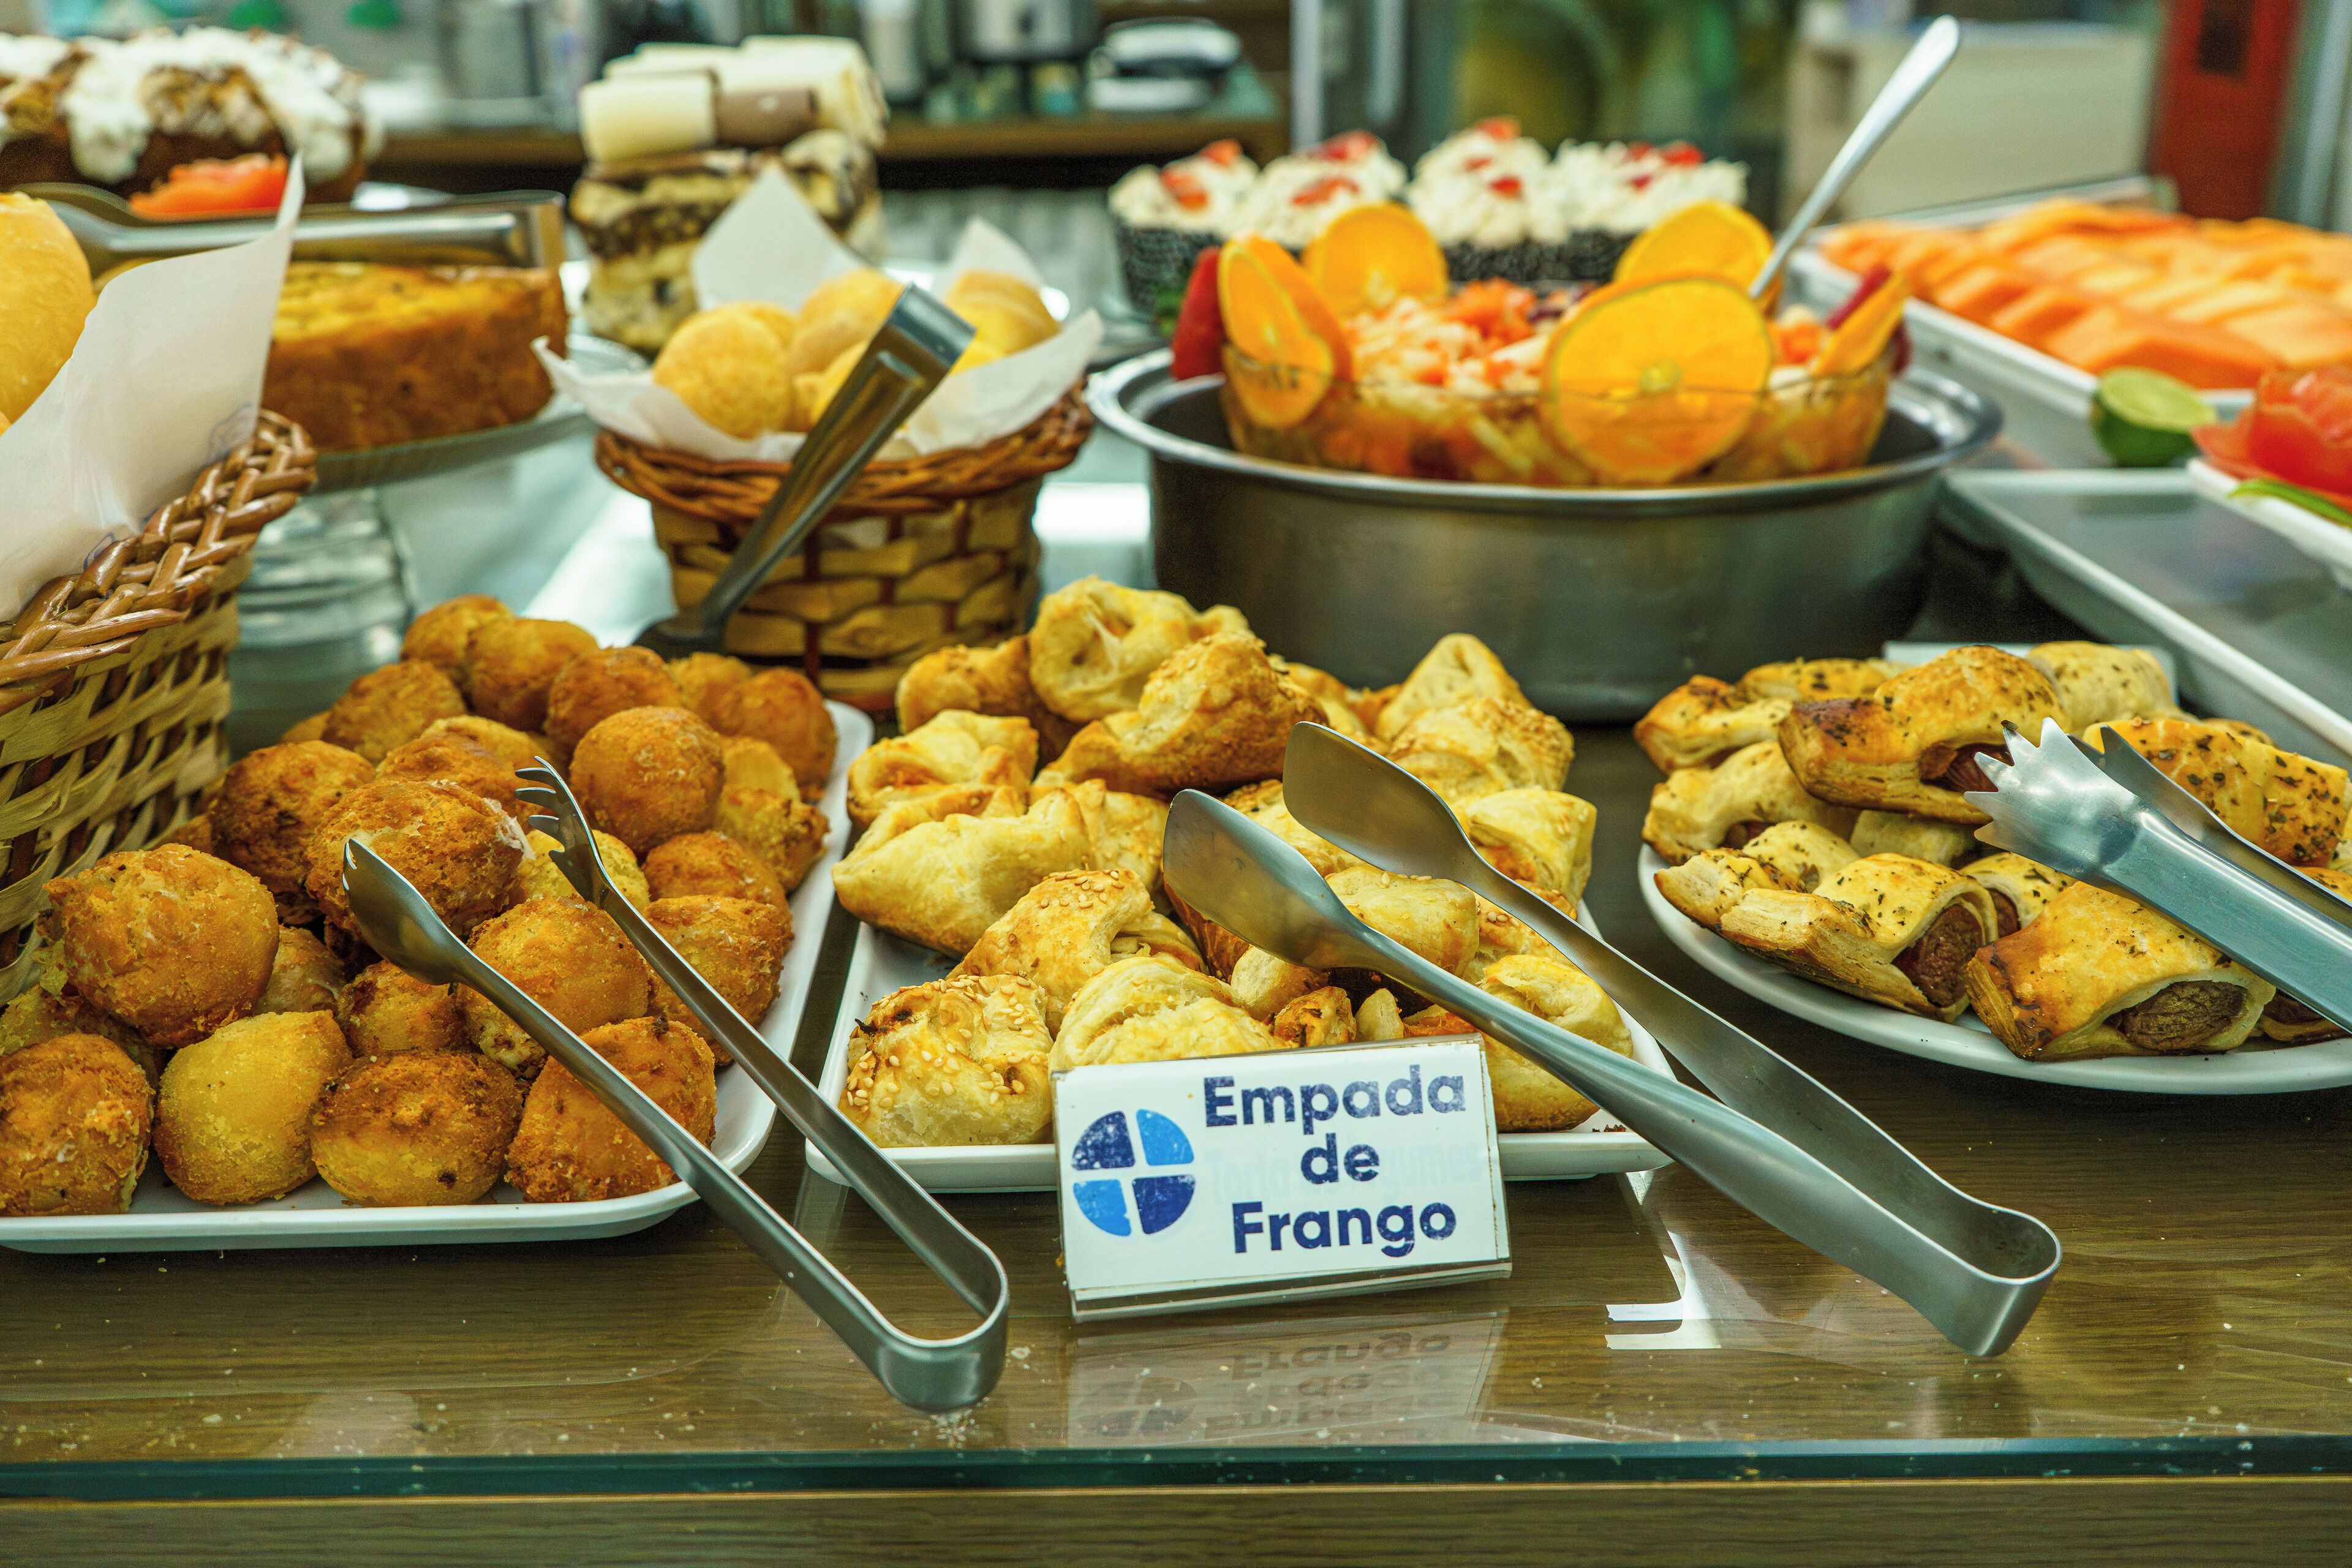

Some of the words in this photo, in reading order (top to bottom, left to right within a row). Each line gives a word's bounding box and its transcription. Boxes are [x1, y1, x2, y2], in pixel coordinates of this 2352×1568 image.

[1203, 1065, 1466, 1135] Empada
[1300, 1133, 1381, 1185] de
[1232, 1201, 1457, 1258] Frango
